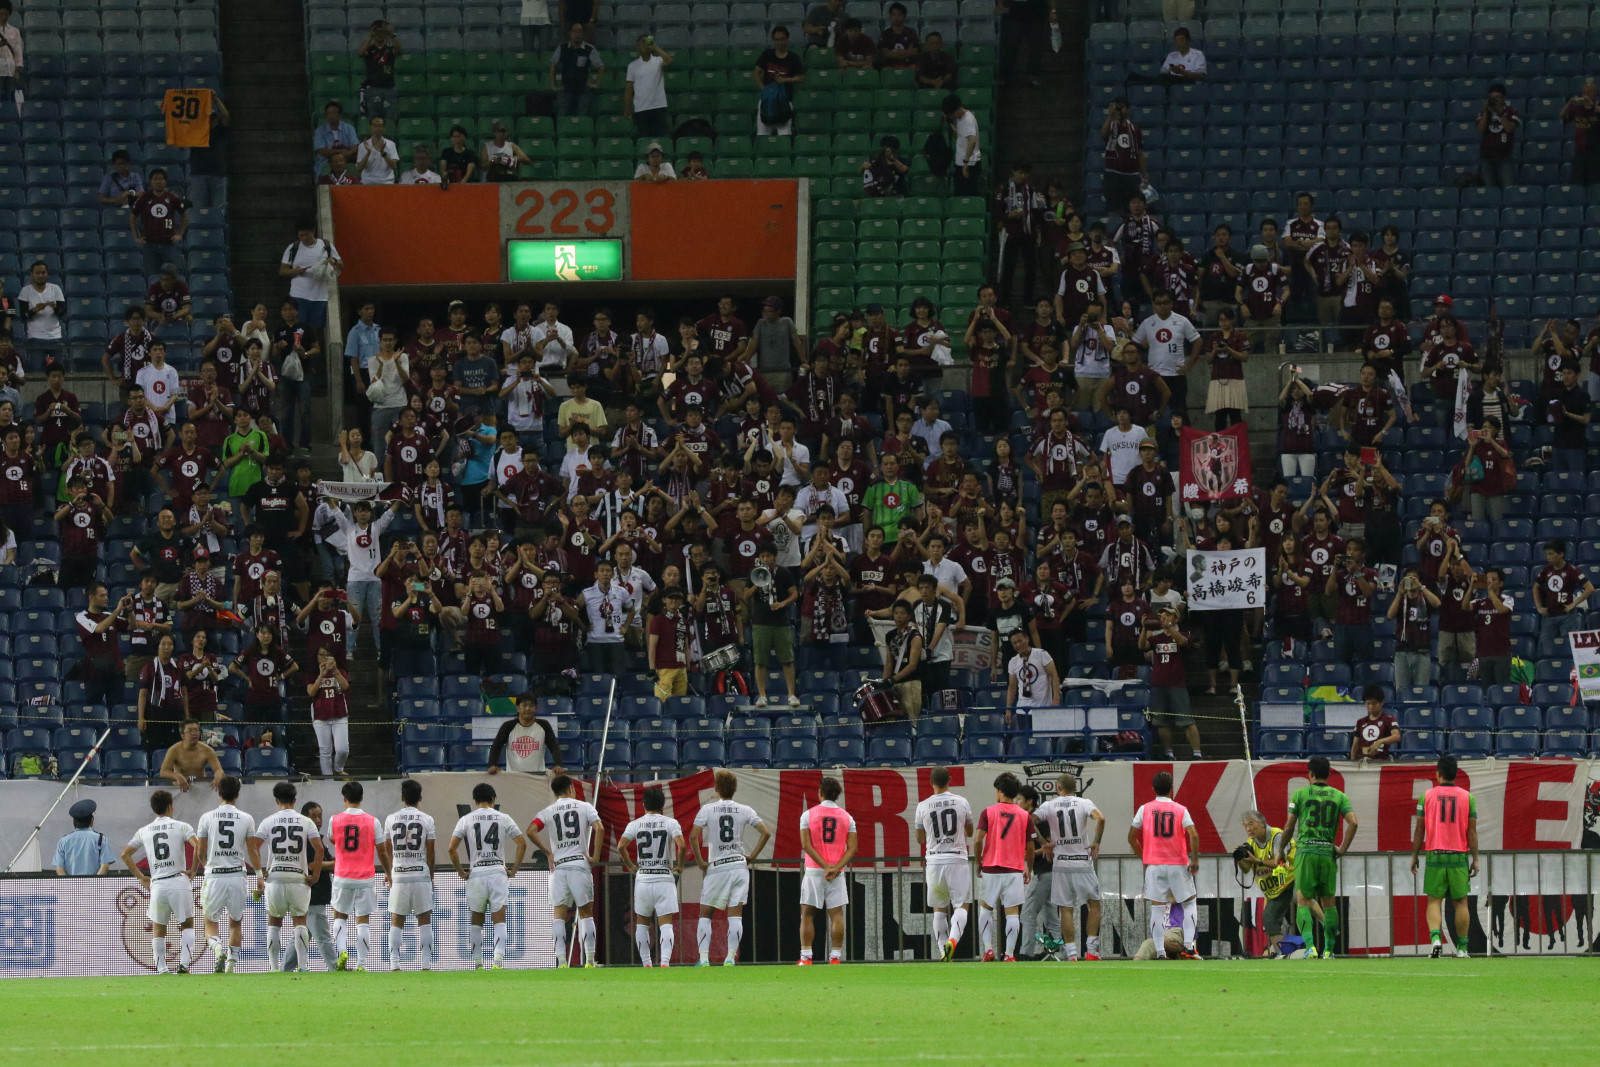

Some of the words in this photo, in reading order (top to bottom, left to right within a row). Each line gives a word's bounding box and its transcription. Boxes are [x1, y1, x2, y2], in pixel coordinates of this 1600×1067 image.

[173, 97, 198, 120] 30
[514, 188, 616, 234] 223
[1359, 283, 1371, 293] 18
[714, 340, 724, 350] 13
[1168, 344, 1177, 353] 13
[1141, 395, 1146, 404] 5
[55, 418, 61, 427] 4
[1485, 460, 1493, 469] 12
[325, 485, 350, 494] VISSEL
[351, 486, 375, 495] KOBE
[1234, 478, 1251, 495] 希
[849, 494, 860, 504] 12
[888, 495, 896, 506] R
[86, 528, 95, 539] 12
[1095, 529, 1104, 540] 13
[1211, 555, 1256, 576] 神戸の
[533, 588, 543, 599] 12
[1246, 590, 1255, 605] 6
[485, 618, 496, 630] 12
[559, 622, 568, 633] 12
[1485, 615, 1491, 625] 3
[332, 633, 341, 643] 12
[1160, 654, 1170, 664] 13
[325, 689, 335, 699] 12
[771, 766, 970, 868] ARE
[1133, 760, 1577, 855] KOBE
[1304, 799, 1338, 829] 30
[1437, 795, 1457, 824] 11
[553, 811, 580, 841] 19
[718, 815, 734, 843] 8
[822, 816, 836, 843] 8
[930, 808, 957, 838] 10
[1000, 813, 1016, 839] 7
[1056, 809, 1078, 838] 11
[1152, 811, 1175, 838] 10
[218, 821, 234, 849] 5
[271, 825, 304, 854] 25
[344, 825, 359, 851] 8
[392, 823, 423, 851] 23
[473, 822, 499, 851] 14
[637, 830, 668, 859] 27
[153, 832, 170, 860] 6
